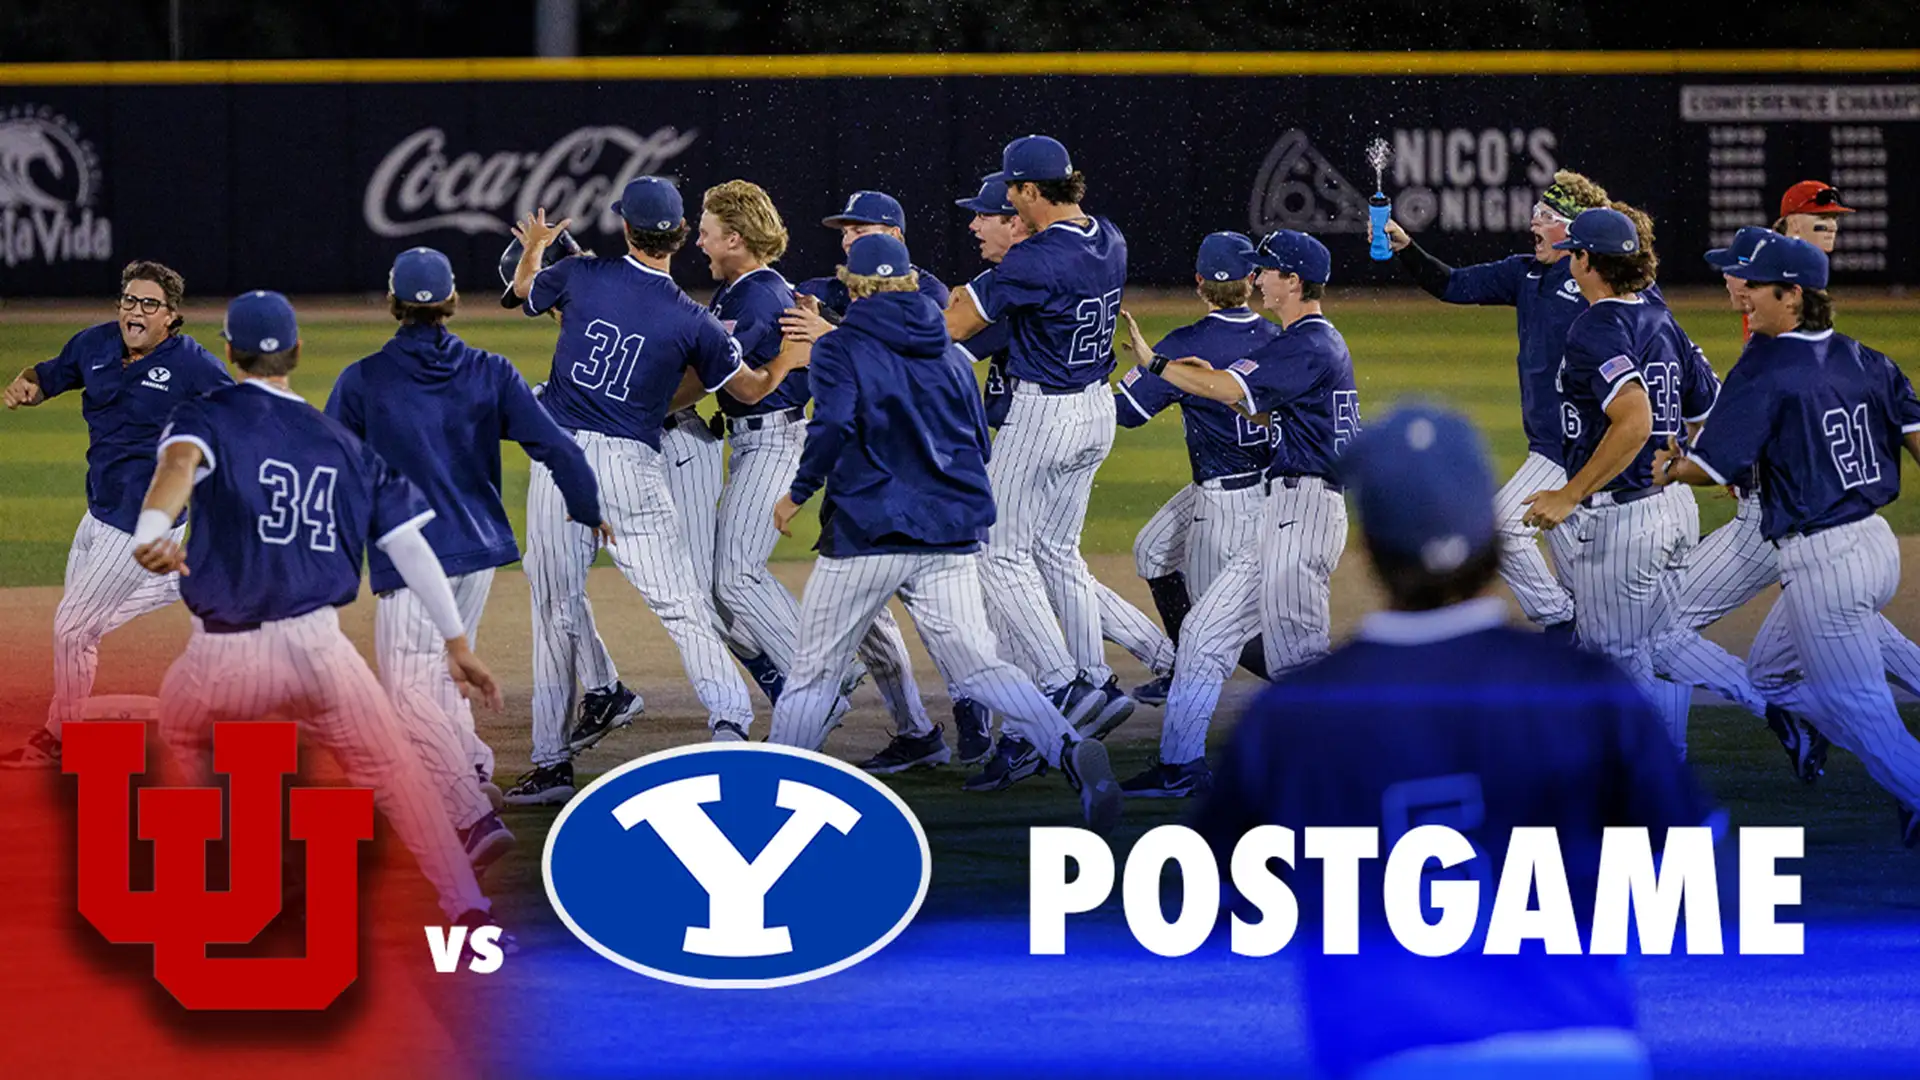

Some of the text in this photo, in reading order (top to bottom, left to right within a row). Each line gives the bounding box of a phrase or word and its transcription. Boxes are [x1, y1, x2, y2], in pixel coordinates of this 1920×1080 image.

[363, 127, 698, 237] Coca-Col
[1393, 127, 1558, 187] NICO'S
[1395, 186, 1544, 232] @NIGH
[571, 318, 646, 401] 31
[1068, 288, 1121, 365] 25
[1644, 362, 1681, 436] 36
[1822, 403, 1881, 491] 21
[257, 458, 338, 553] 34
